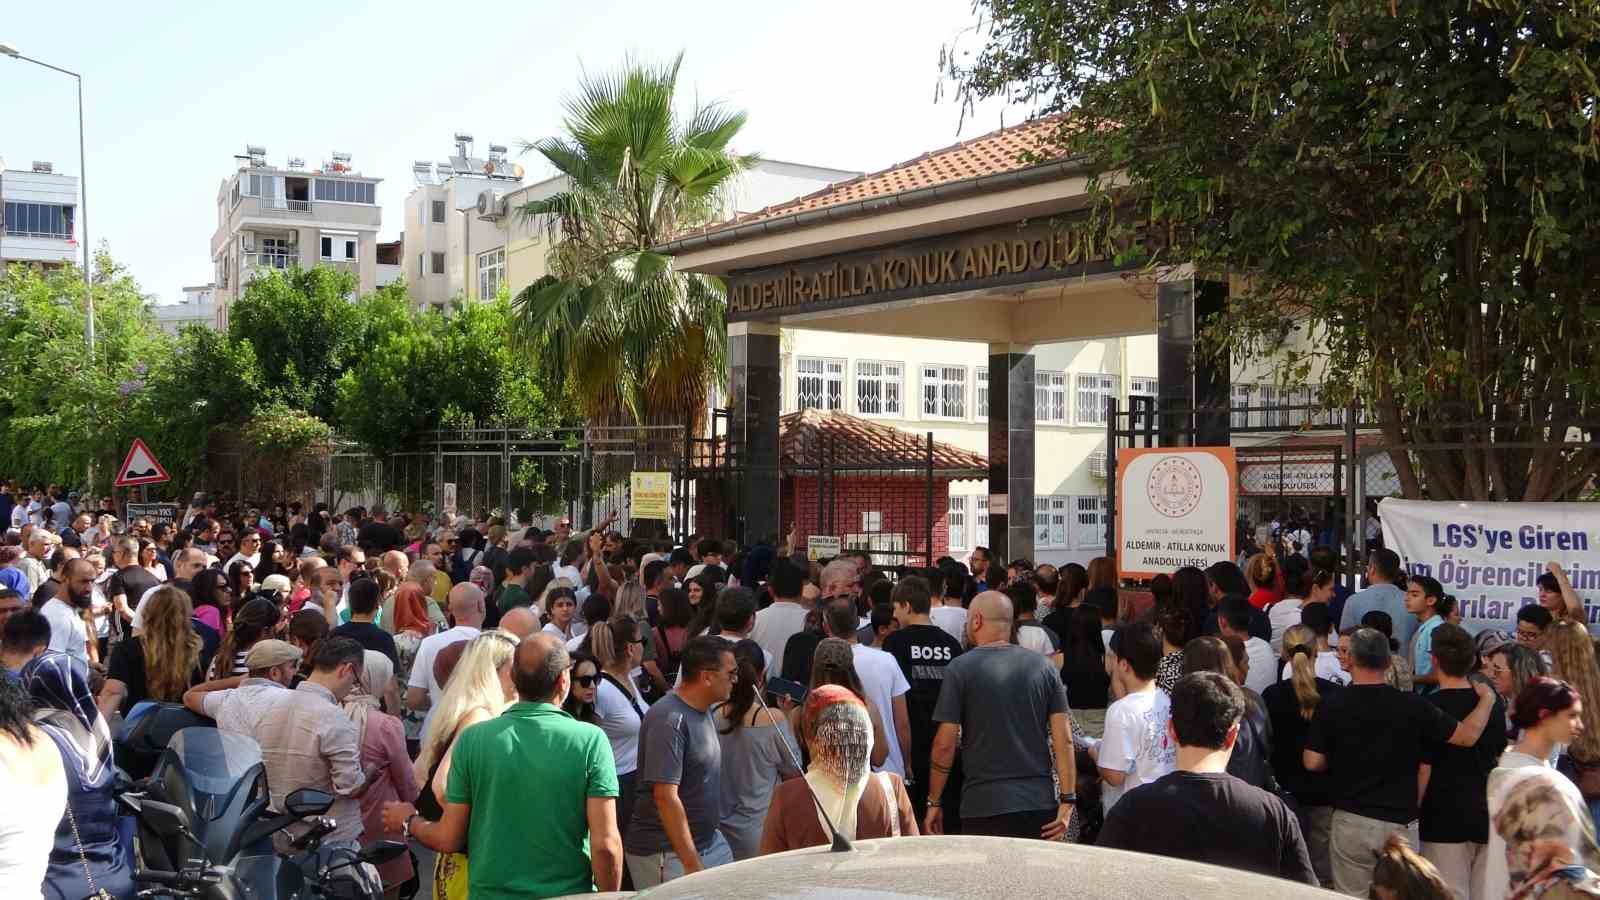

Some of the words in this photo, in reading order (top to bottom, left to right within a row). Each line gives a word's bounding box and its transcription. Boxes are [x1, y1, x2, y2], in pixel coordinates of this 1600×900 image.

[730, 261, 876, 312] ALDEMİR-ATİLLA
[881, 248, 957, 291] KONUK
[1518, 524, 1589, 551] Giren
[1195, 543, 1226, 553] KONUK
[1142, 556, 1182, 567] ANADOLU
[910, 645, 952, 661] BOSS
